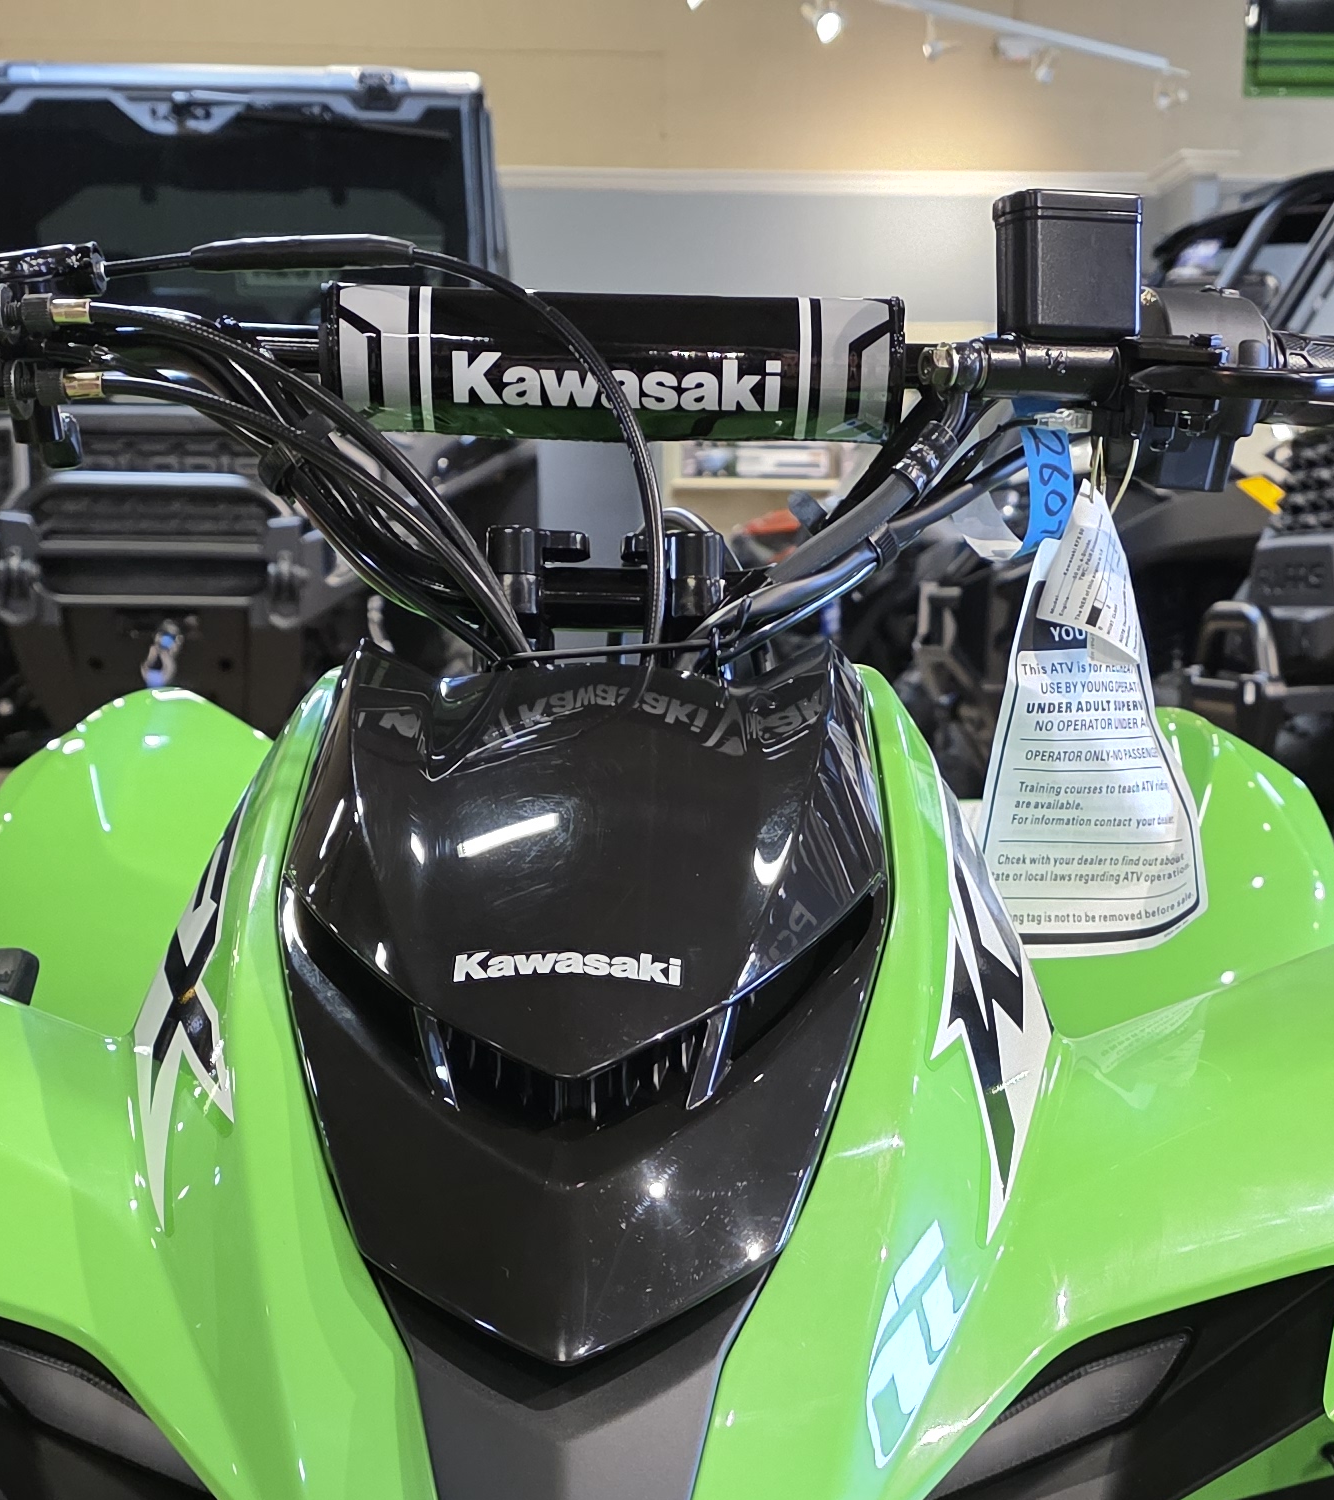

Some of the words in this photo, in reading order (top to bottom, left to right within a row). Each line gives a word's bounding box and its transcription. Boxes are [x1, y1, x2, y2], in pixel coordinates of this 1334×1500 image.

[451, 350, 782, 412] Kawasaki
[1021, 663, 1047, 675] This
[1050, 661, 1074, 674] ATV
[1077, 661, 1086, 673] is
[1041, 682, 1063, 694] USE
[1065, 681, 1078, 693] BY
[1081, 681, 1114, 693] YOUNG
[1026, 702, 1073, 714] UNDER
[1076, 700, 1111, 712] ADULT
[1034, 720, 1054, 732] NO
[1057, 718, 1113, 731] OPERATOR
[1025, 750, 1082, 762] OPERATOR
[1019, 781, 1062, 796] Training
[1064, 786, 1103, 795] courses
[1106, 784, 1116, 794] to
[1118, 782, 1139, 794] teach
[1141, 780, 1154, 792] ATV
[1015, 800, 1031, 809] are
[1034, 800, 1084, 810] available.
[1011, 814, 1028, 825] For
[1030, 814, 1091, 826] information
[1094, 817, 1132, 827] contact
[1136, 819, 1155, 829] your
[1029, 854, 1051, 865] with
[1053, 856, 1075, 867] your
[1077, 855, 1107, 866] dealer
[1109, 857, 1119, 866] to
[1121, 855, 1140, 866] find
[1142, 857, 1158, 867] out
[1160, 853, 1185, 867] about
[1012, 872, 1023, 881] or
[1024, 871, 1048, 882] local
[1050, 871, 1072, 882] laws
[1074, 871, 1121, 885] regarding
[1122, 871, 1143, 882] ATV
[1144, 863, 1191, 885] operation.
[1027, 913, 1042, 925] tag
[1044, 912, 1052, 923] is
[1054, 914, 1070, 923] not
[1073, 913, 1082, 923] to
[1085, 912, 1096, 923] be
[1099, 910, 1142, 923] removed
[1145, 903, 1175, 919] before
[453, 951, 682, 986] Kawasaki
